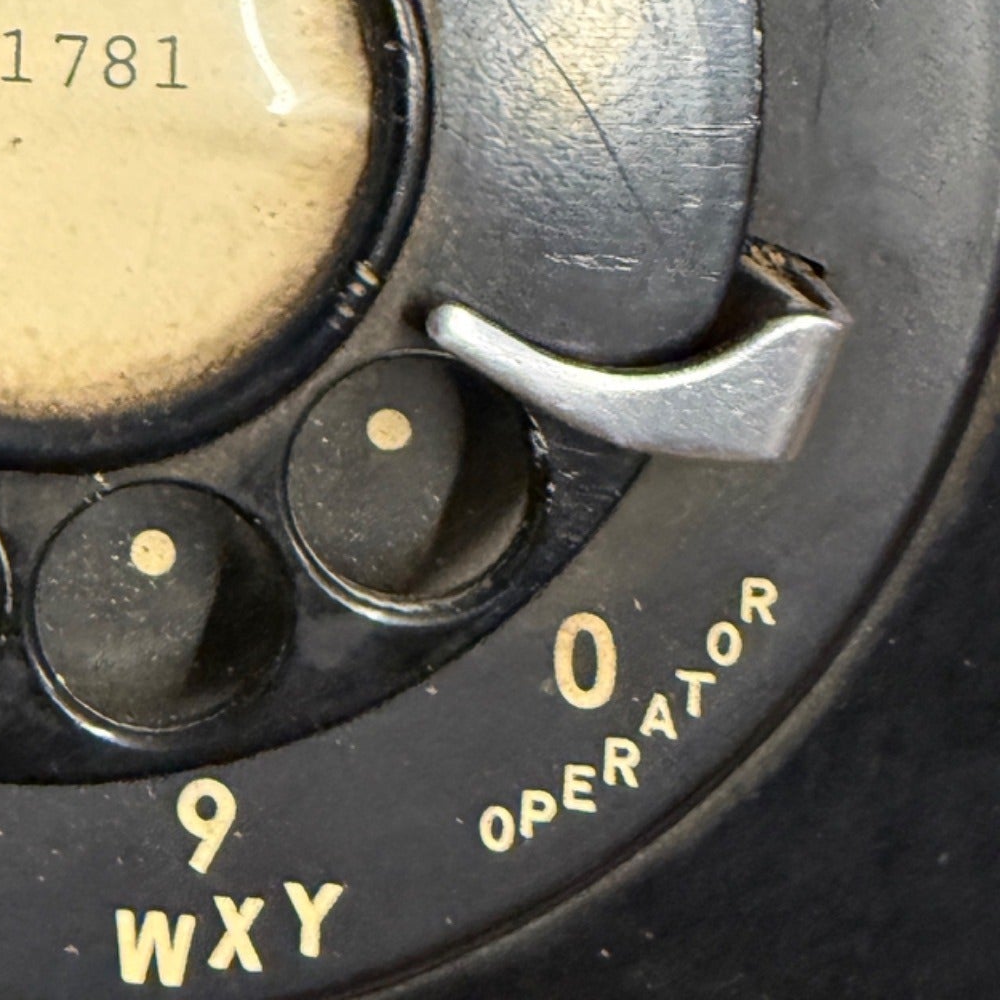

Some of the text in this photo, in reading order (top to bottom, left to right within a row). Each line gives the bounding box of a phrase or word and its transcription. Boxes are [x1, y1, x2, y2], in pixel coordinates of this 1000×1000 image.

[554, 612, 617, 709] 0
[479, 577, 779, 852] OPERATOR
[177, 778, 237, 874] 9
[116, 882, 346, 987] WXY
